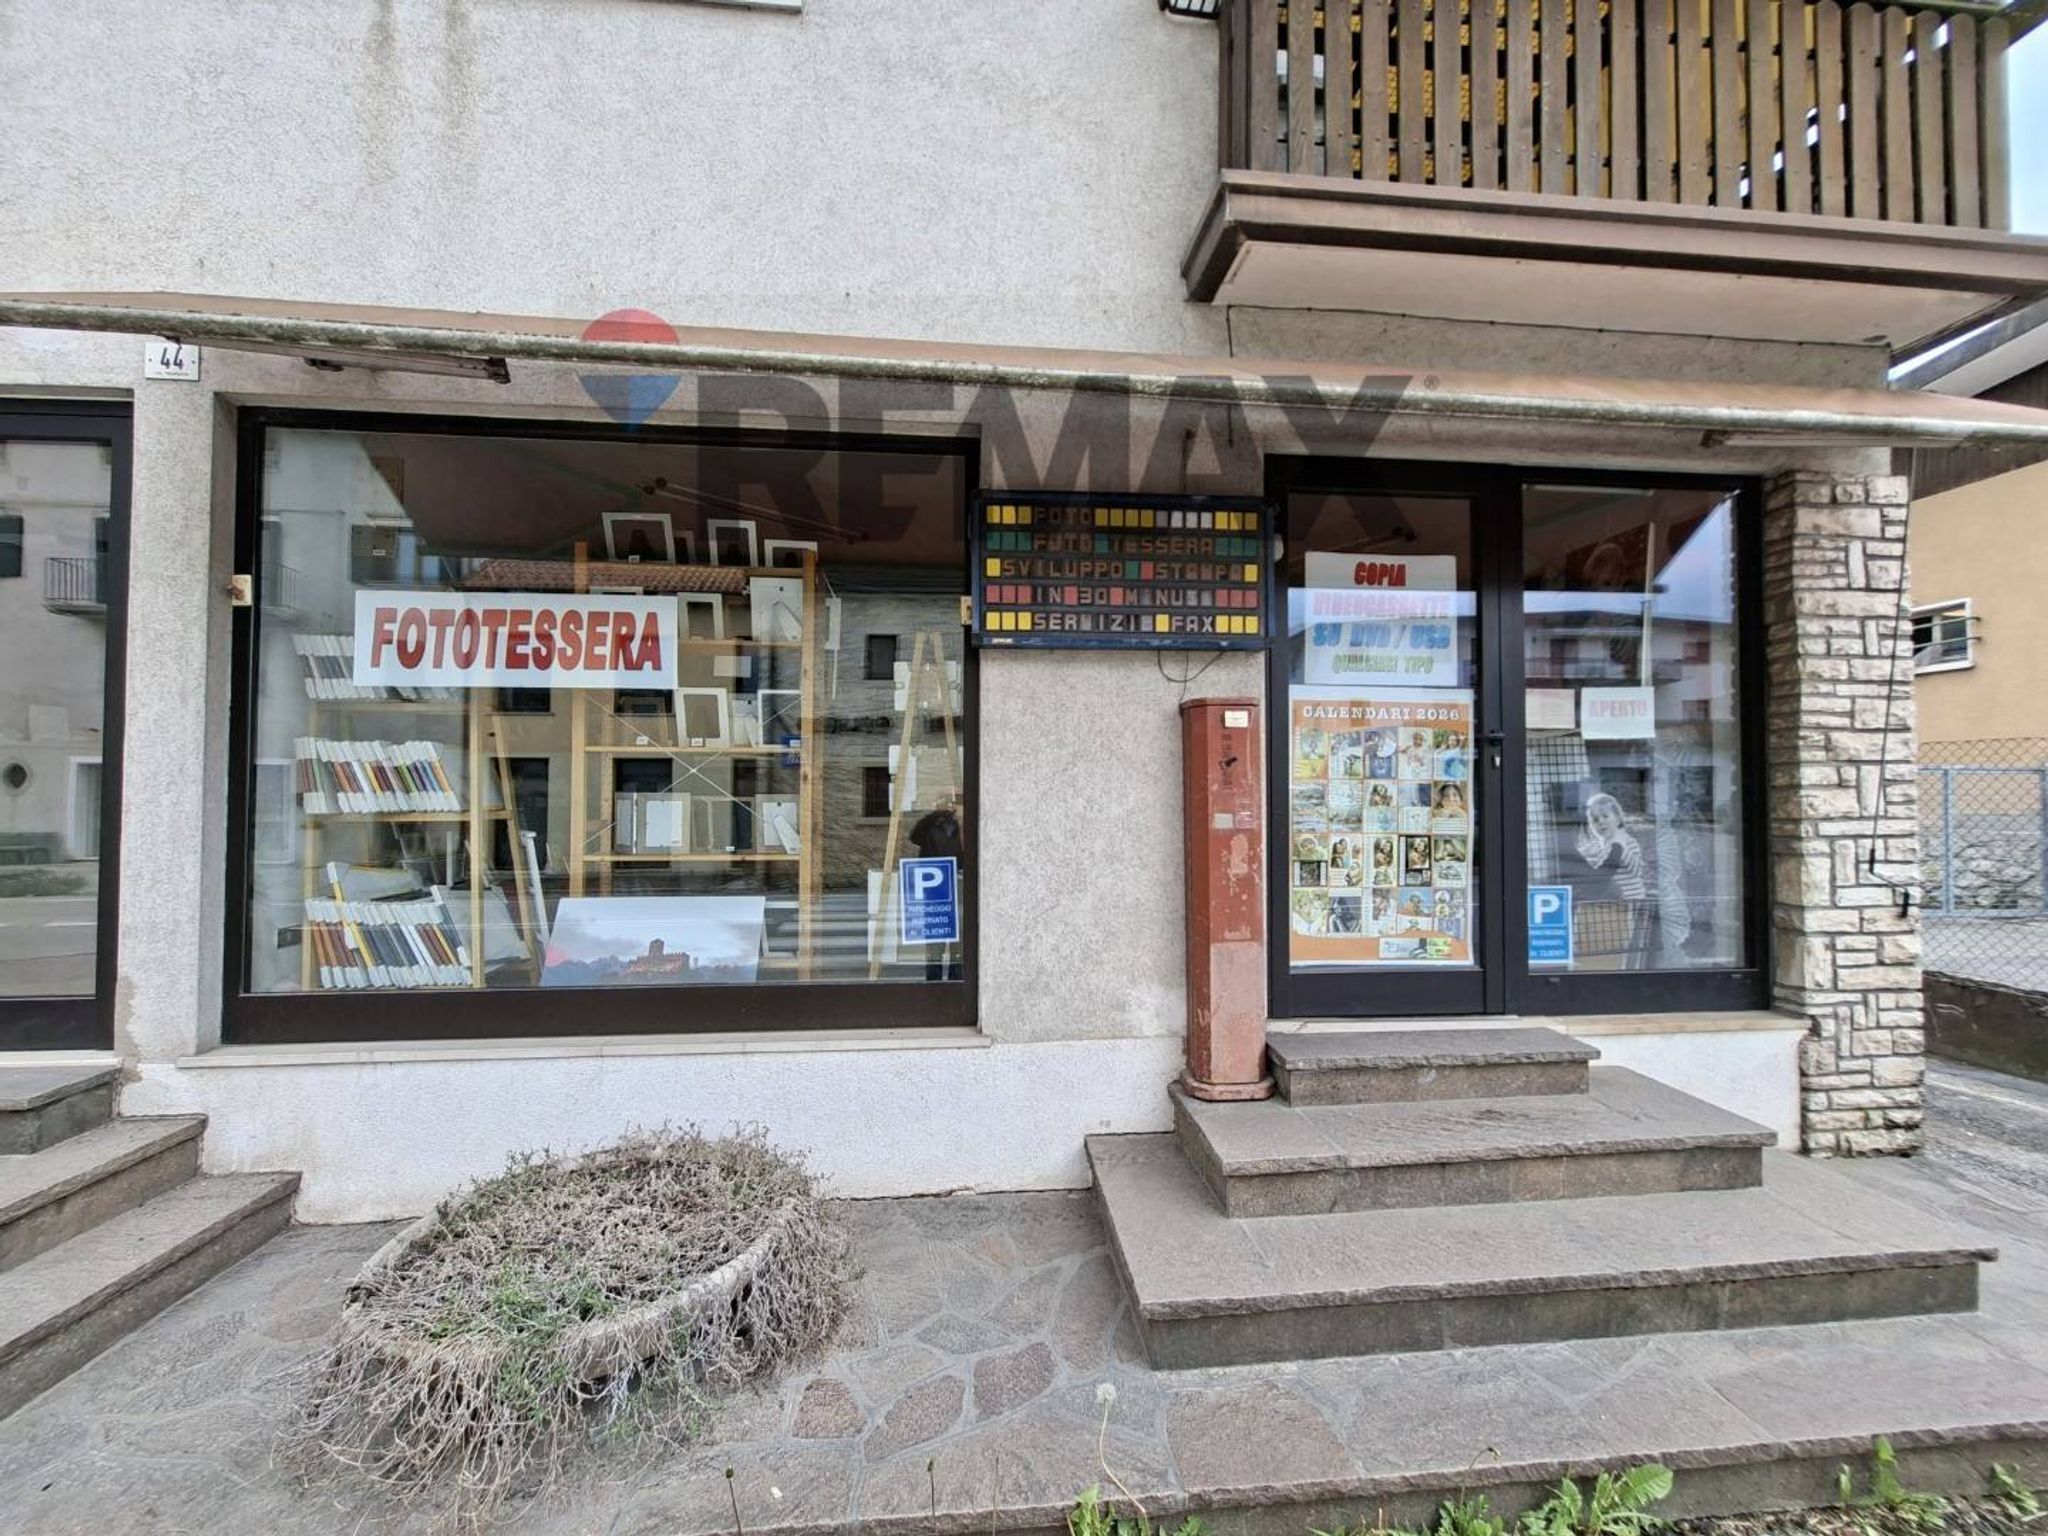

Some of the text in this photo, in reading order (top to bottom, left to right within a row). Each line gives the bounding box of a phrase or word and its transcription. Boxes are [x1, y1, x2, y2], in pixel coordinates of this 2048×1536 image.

[160, 345, 184, 369] 44
[1034, 506, 1092, 525] FOTO
[1034, 533, 1213, 556] FOTO TESSERA
[1003, 557, 1123, 578] SVILUPPO
[1353, 561, 1407, 586] COPIA
[1036, 586, 1062, 604] IN
[1080, 587, 1108, 605] 30
[1171, 615, 1213, 633] FAX
[370, 607, 662, 671] FOTOTESSERA
[1302, 705, 1412, 722] CALENDARI
[1588, 699, 1648, 718] APERTO
[913, 867, 943, 900] P
[1534, 893, 1560, 924] P
